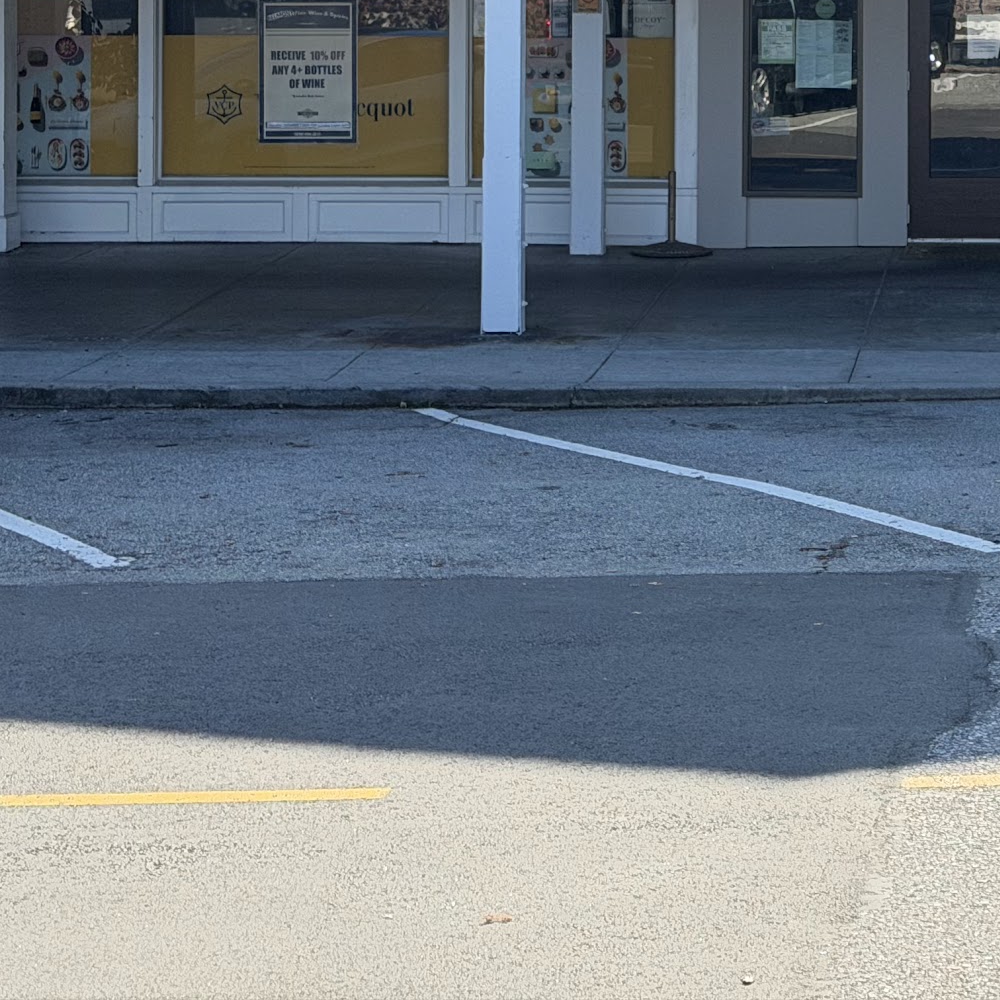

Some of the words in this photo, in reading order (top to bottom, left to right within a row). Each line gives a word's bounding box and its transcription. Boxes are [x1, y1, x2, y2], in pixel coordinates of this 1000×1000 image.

[270, 50, 306, 61] RECEIVE
[310, 50, 329, 61] 10%
[330, 50, 346, 61] OFF
[271, 65, 289, 75] ANY
[290, 65, 303, 75] 4+
[304, 65, 343, 75] BOTTLES
[289, 79, 300, 89] OF
[301, 79, 326, 89] WINE
[357, 99, 415, 122] cquot
